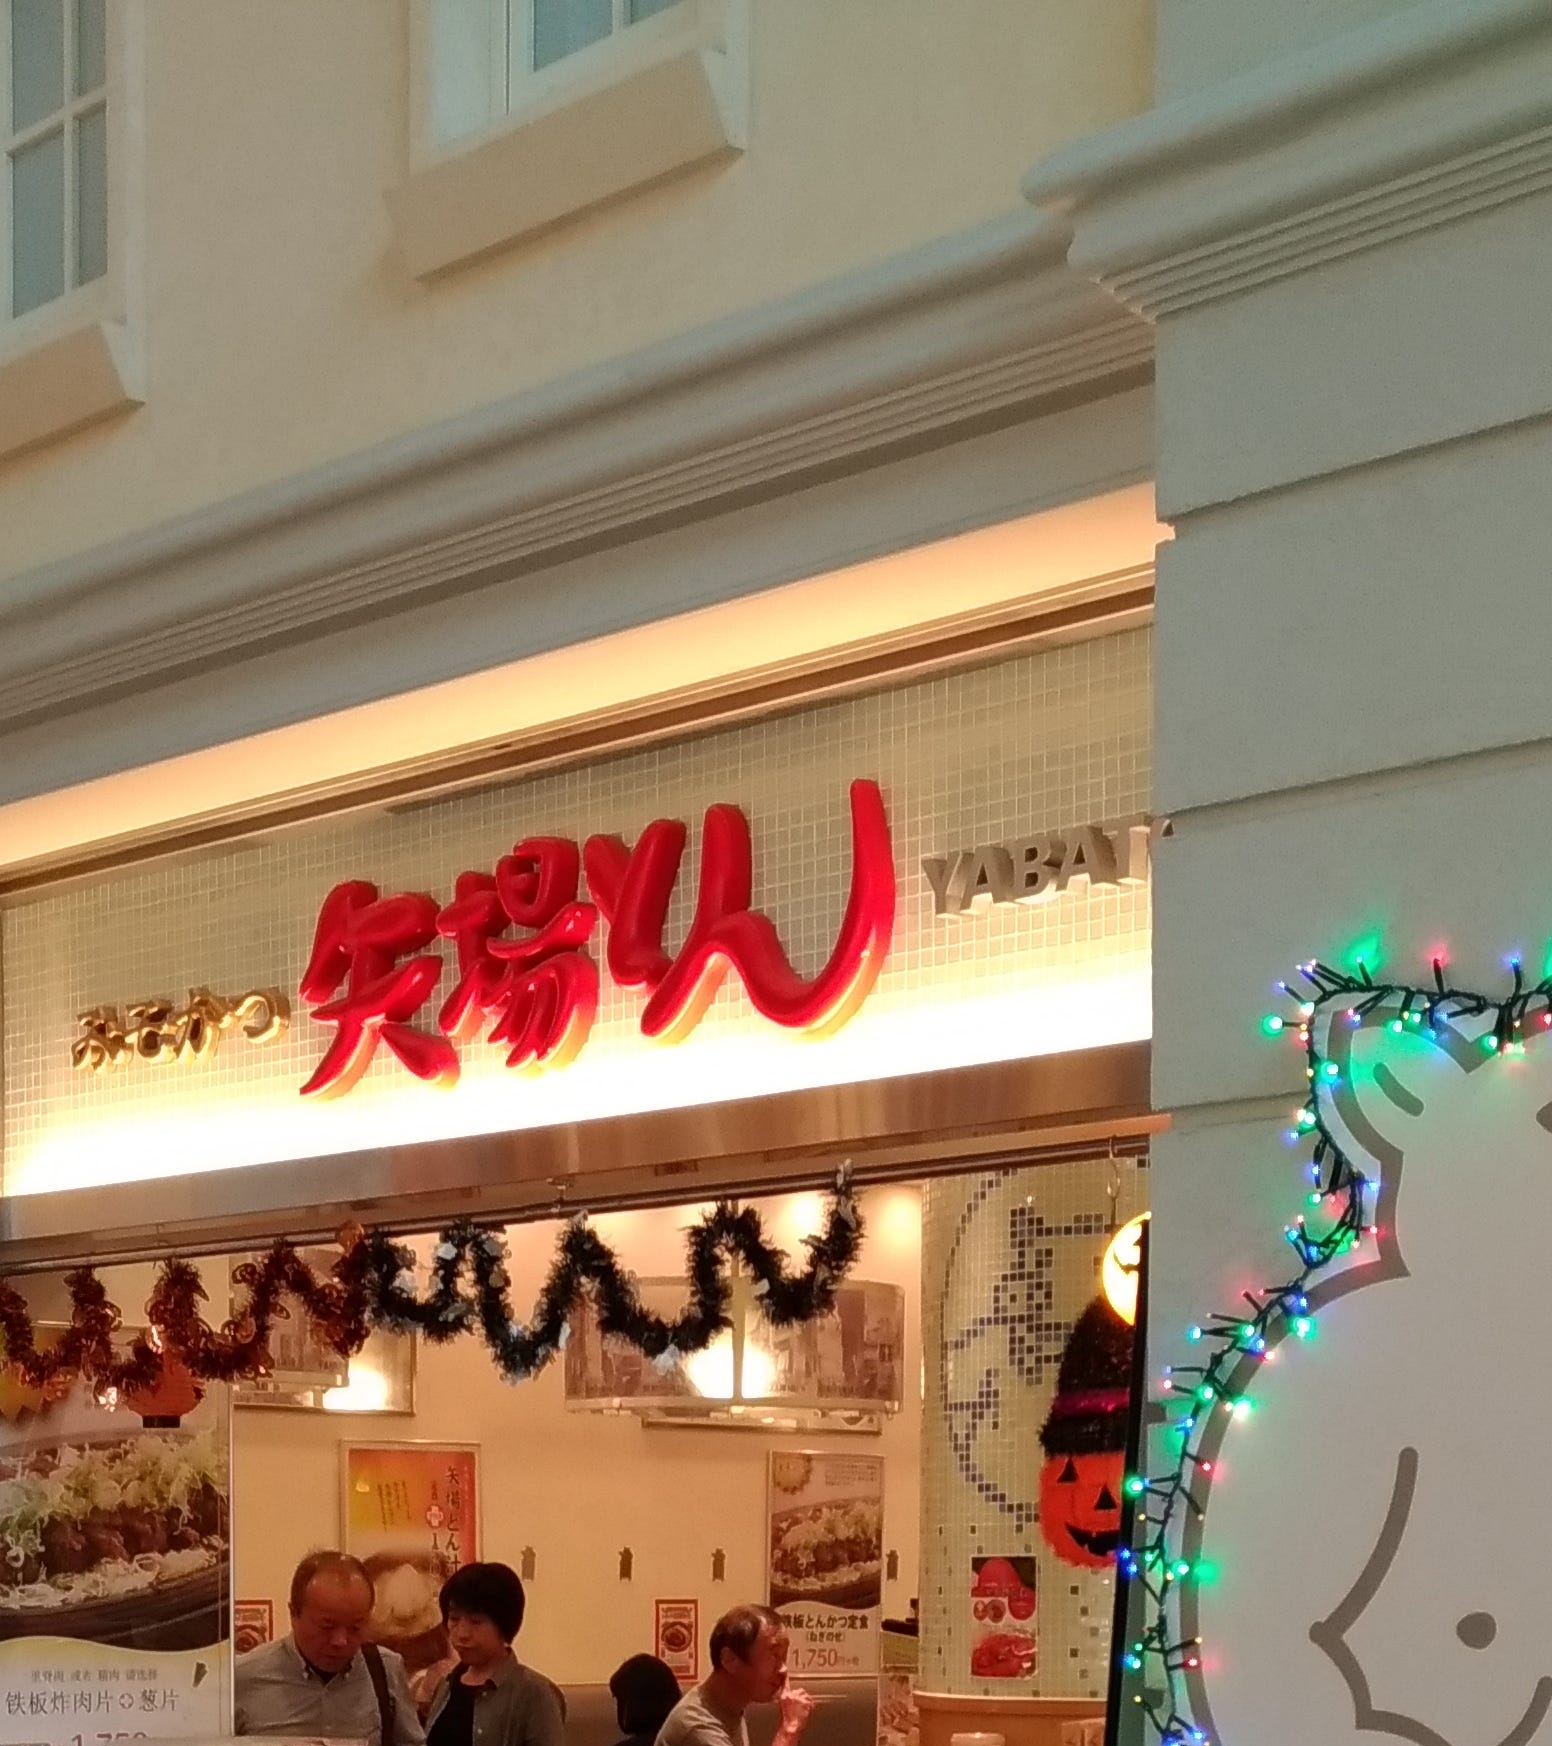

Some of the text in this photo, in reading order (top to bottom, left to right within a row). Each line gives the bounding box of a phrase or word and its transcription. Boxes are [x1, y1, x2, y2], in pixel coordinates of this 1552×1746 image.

[299, 778, 899, 1099] 矢場とん
[5, 1688, 179, 1716] 铁板炸肉片 葱片
